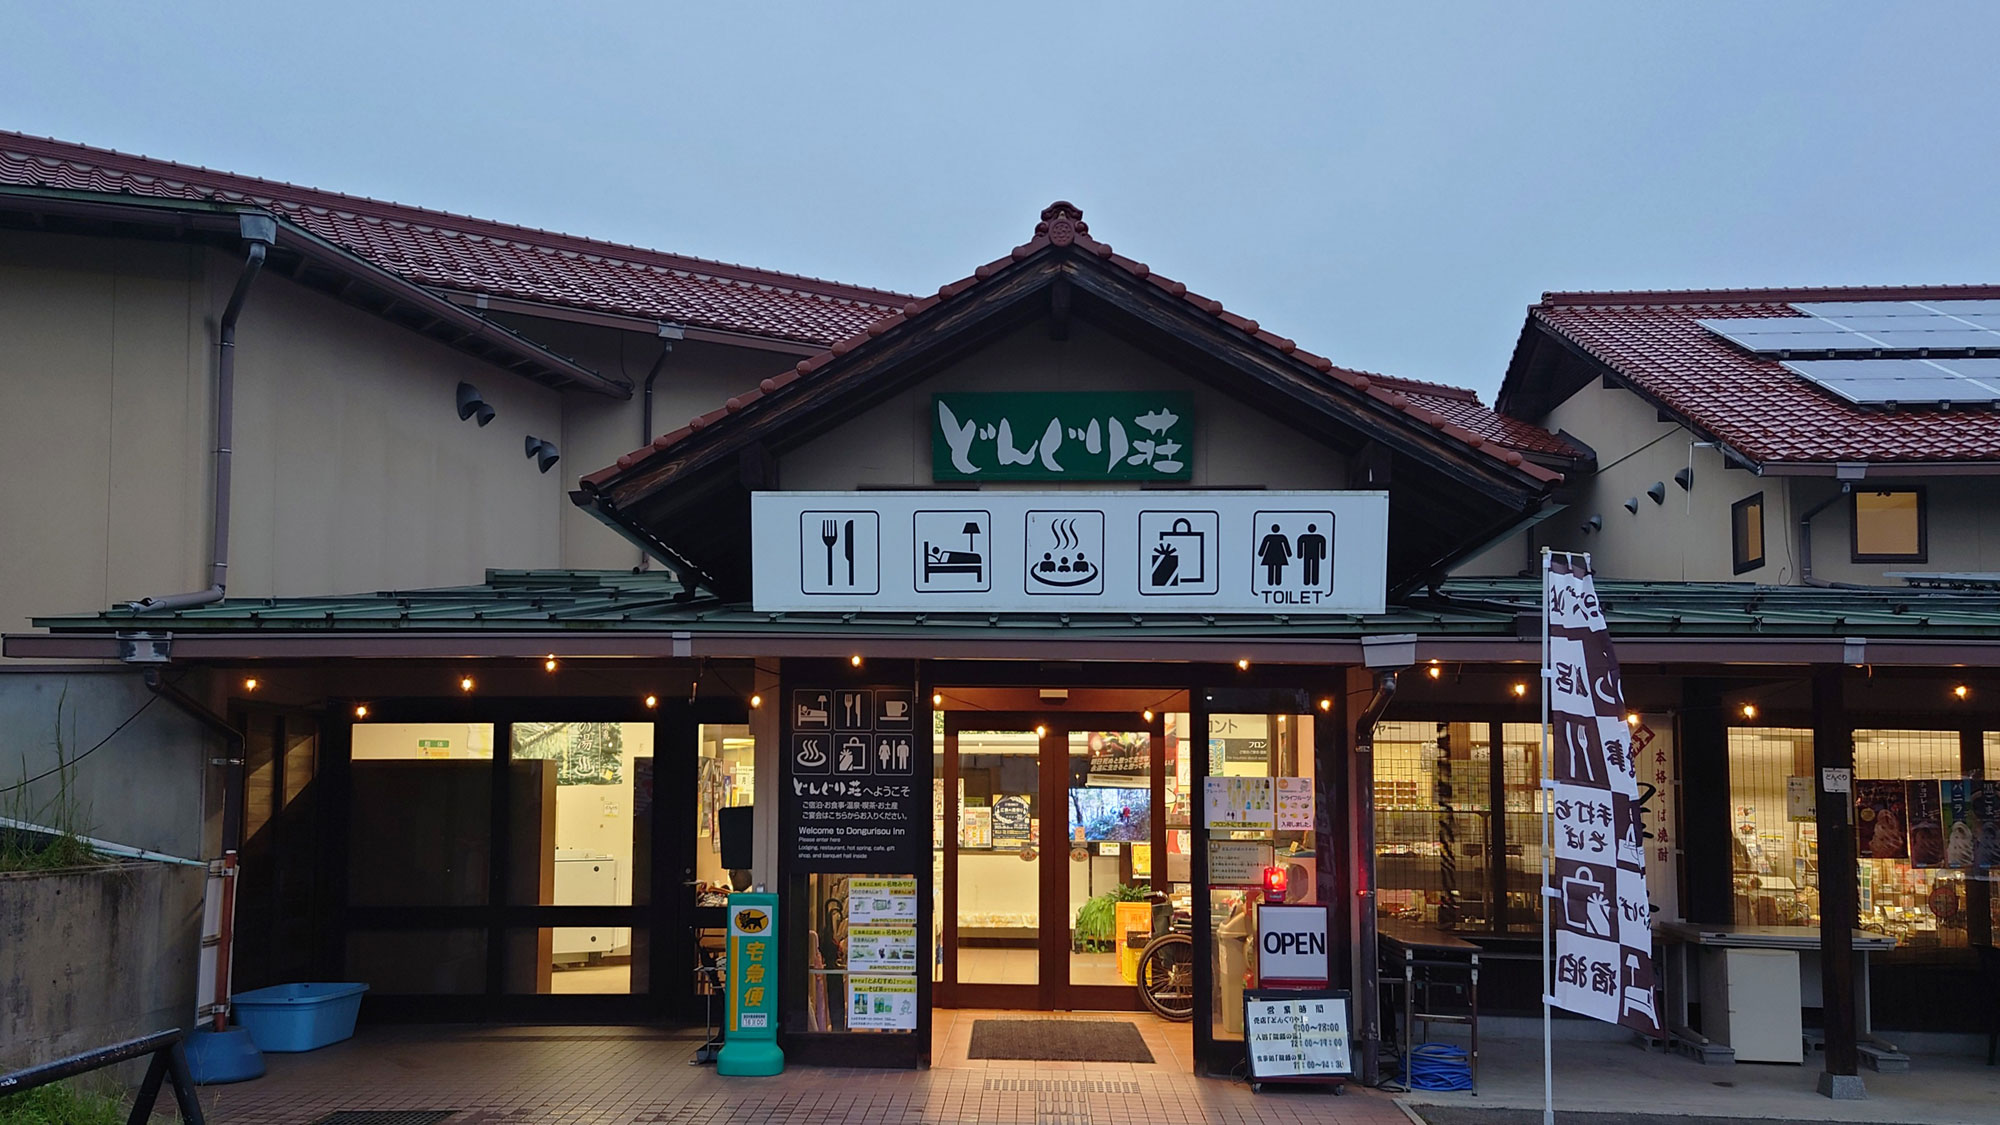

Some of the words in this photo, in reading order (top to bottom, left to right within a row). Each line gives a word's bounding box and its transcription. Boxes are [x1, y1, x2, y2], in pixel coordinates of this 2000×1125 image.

[938, 399, 1185, 475] どんぐり荘
[1262, 590, 1322, 605] TOILET
[793, 777, 911, 797] どんぐり荘へようこそ
[1952, 783, 1963, 813] バニラ
[799, 827, 834, 835] Welcome
[836, 827, 845, 835] to
[846, 827, 890, 836] Dongurisou
[892, 827, 905, 835] Inn
[1263, 931, 1326, 955] OPEN
[743, 941, 766, 1007] 宅急便
